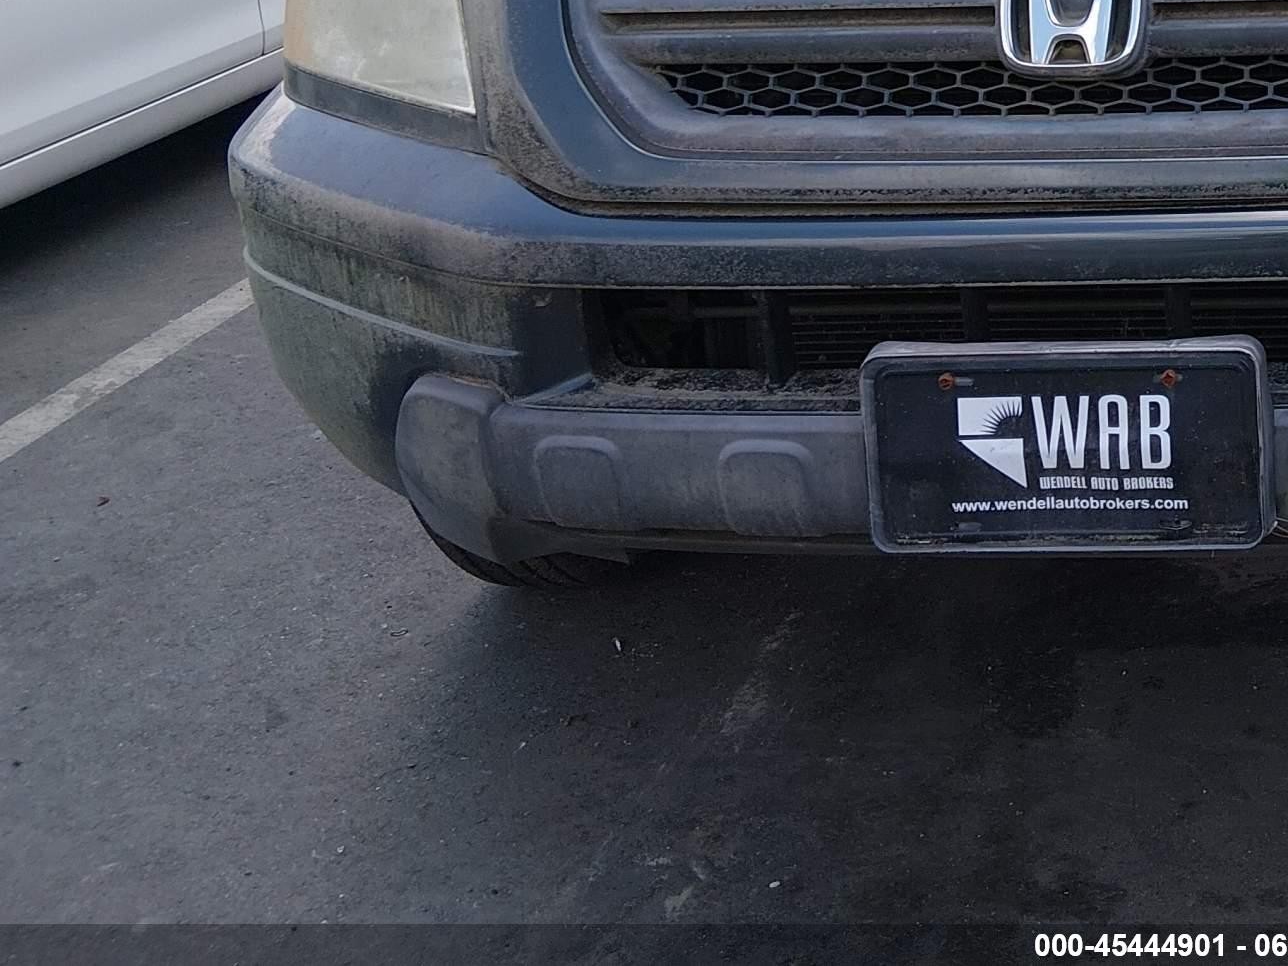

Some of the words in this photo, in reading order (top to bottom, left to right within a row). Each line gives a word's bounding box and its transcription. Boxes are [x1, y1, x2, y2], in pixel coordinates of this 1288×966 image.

[1031, 393, 1173, 471] WAB
[1039, 476, 1088, 490] WENDELL
[1090, 476, 1119, 491] AUTO
[1123, 476, 1175, 490] BROKERS
[951, 496, 1190, 513] www.wendellautobrokers.com
